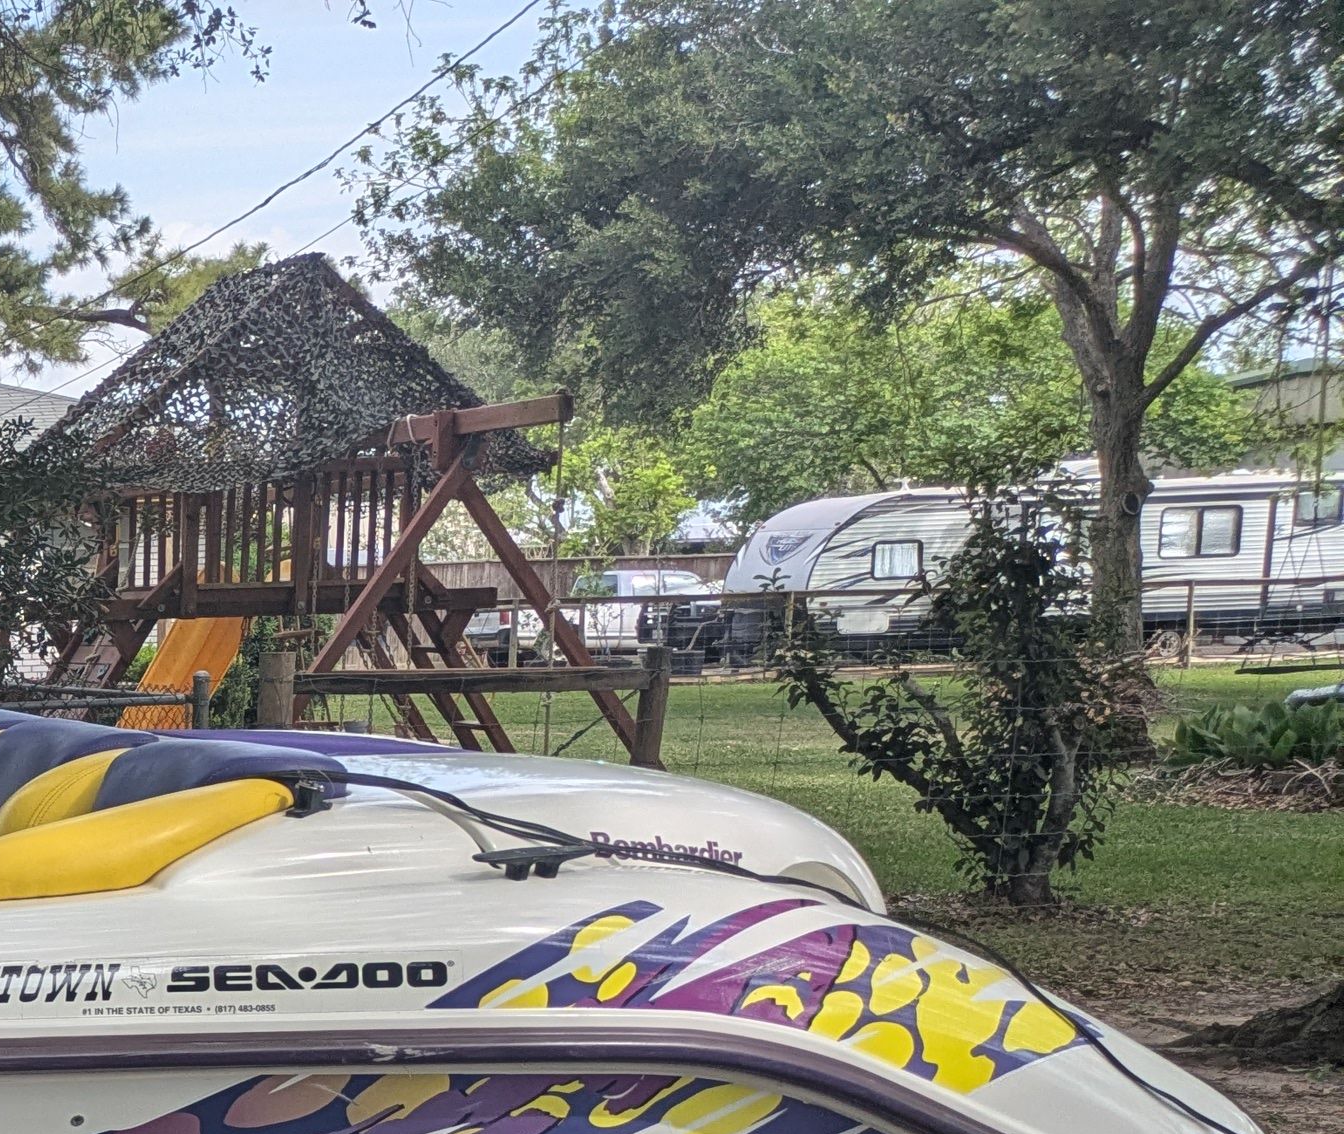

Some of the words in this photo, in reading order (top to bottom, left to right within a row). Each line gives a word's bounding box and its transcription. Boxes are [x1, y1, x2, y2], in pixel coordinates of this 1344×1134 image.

[589, 831, 743, 867] Bombardier
[94, 1007, 104, 1016] IN
[107, 1007, 124, 1015] THE
[126, 1006, 156, 1015] STATE
[157, 1006, 171, 1015] OF
[172, 1005, 203, 1014] TEXAS
[214, 1004, 236, 1015] (817)
